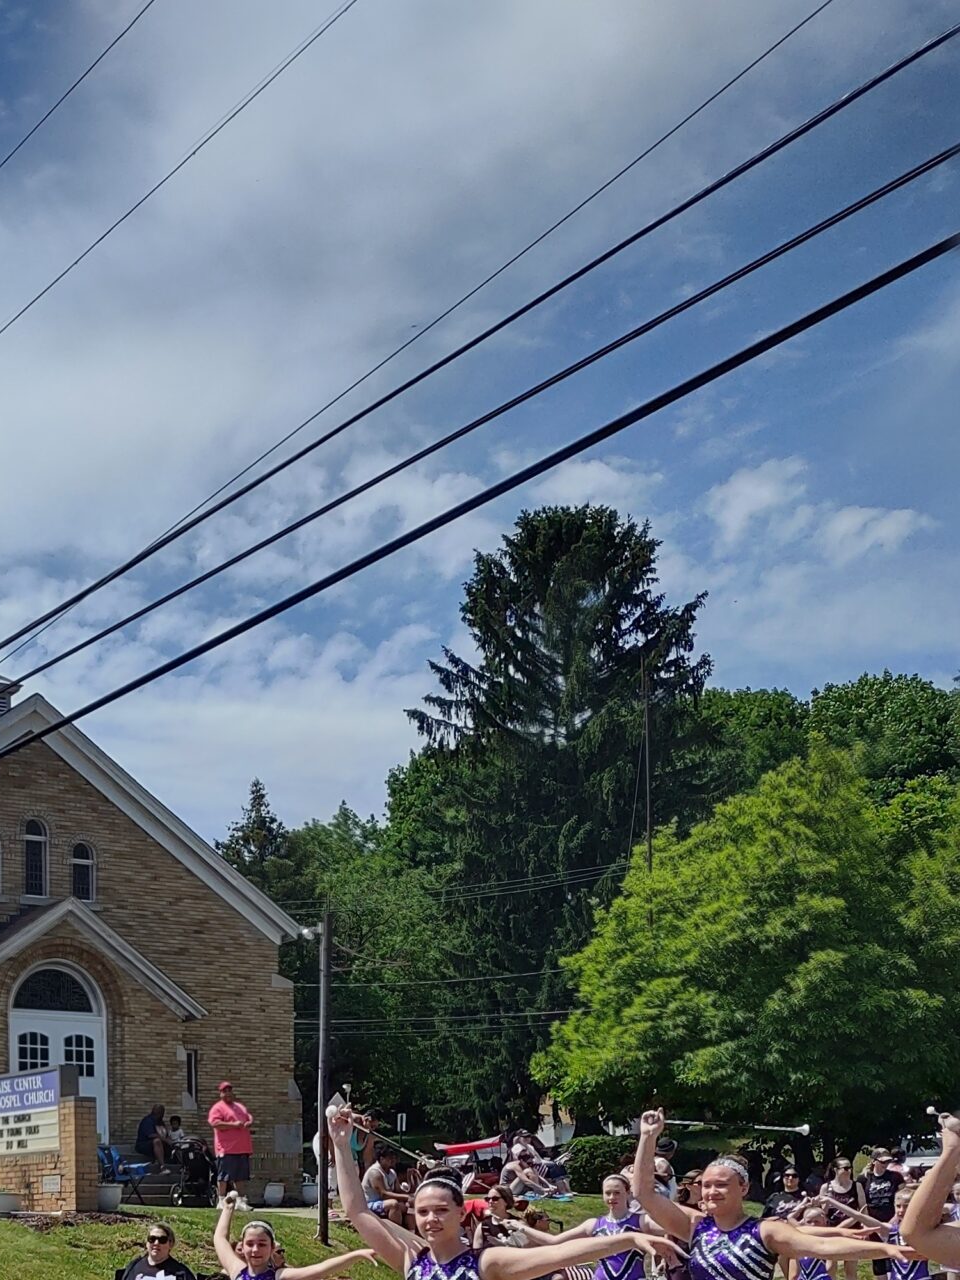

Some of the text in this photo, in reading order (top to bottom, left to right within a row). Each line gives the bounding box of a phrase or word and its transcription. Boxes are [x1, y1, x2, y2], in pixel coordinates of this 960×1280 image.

[14, 1076, 42, 1091] CENTER
[24, 1089, 55, 1106] CHURCH
[1, 1113, 31, 1125] THE CHURCH
[7, 1127, 22, 1137] YOUNG
[25, 1125, 40, 1135] FOLKS
[6, 1139, 28, 1150] DO WELL
